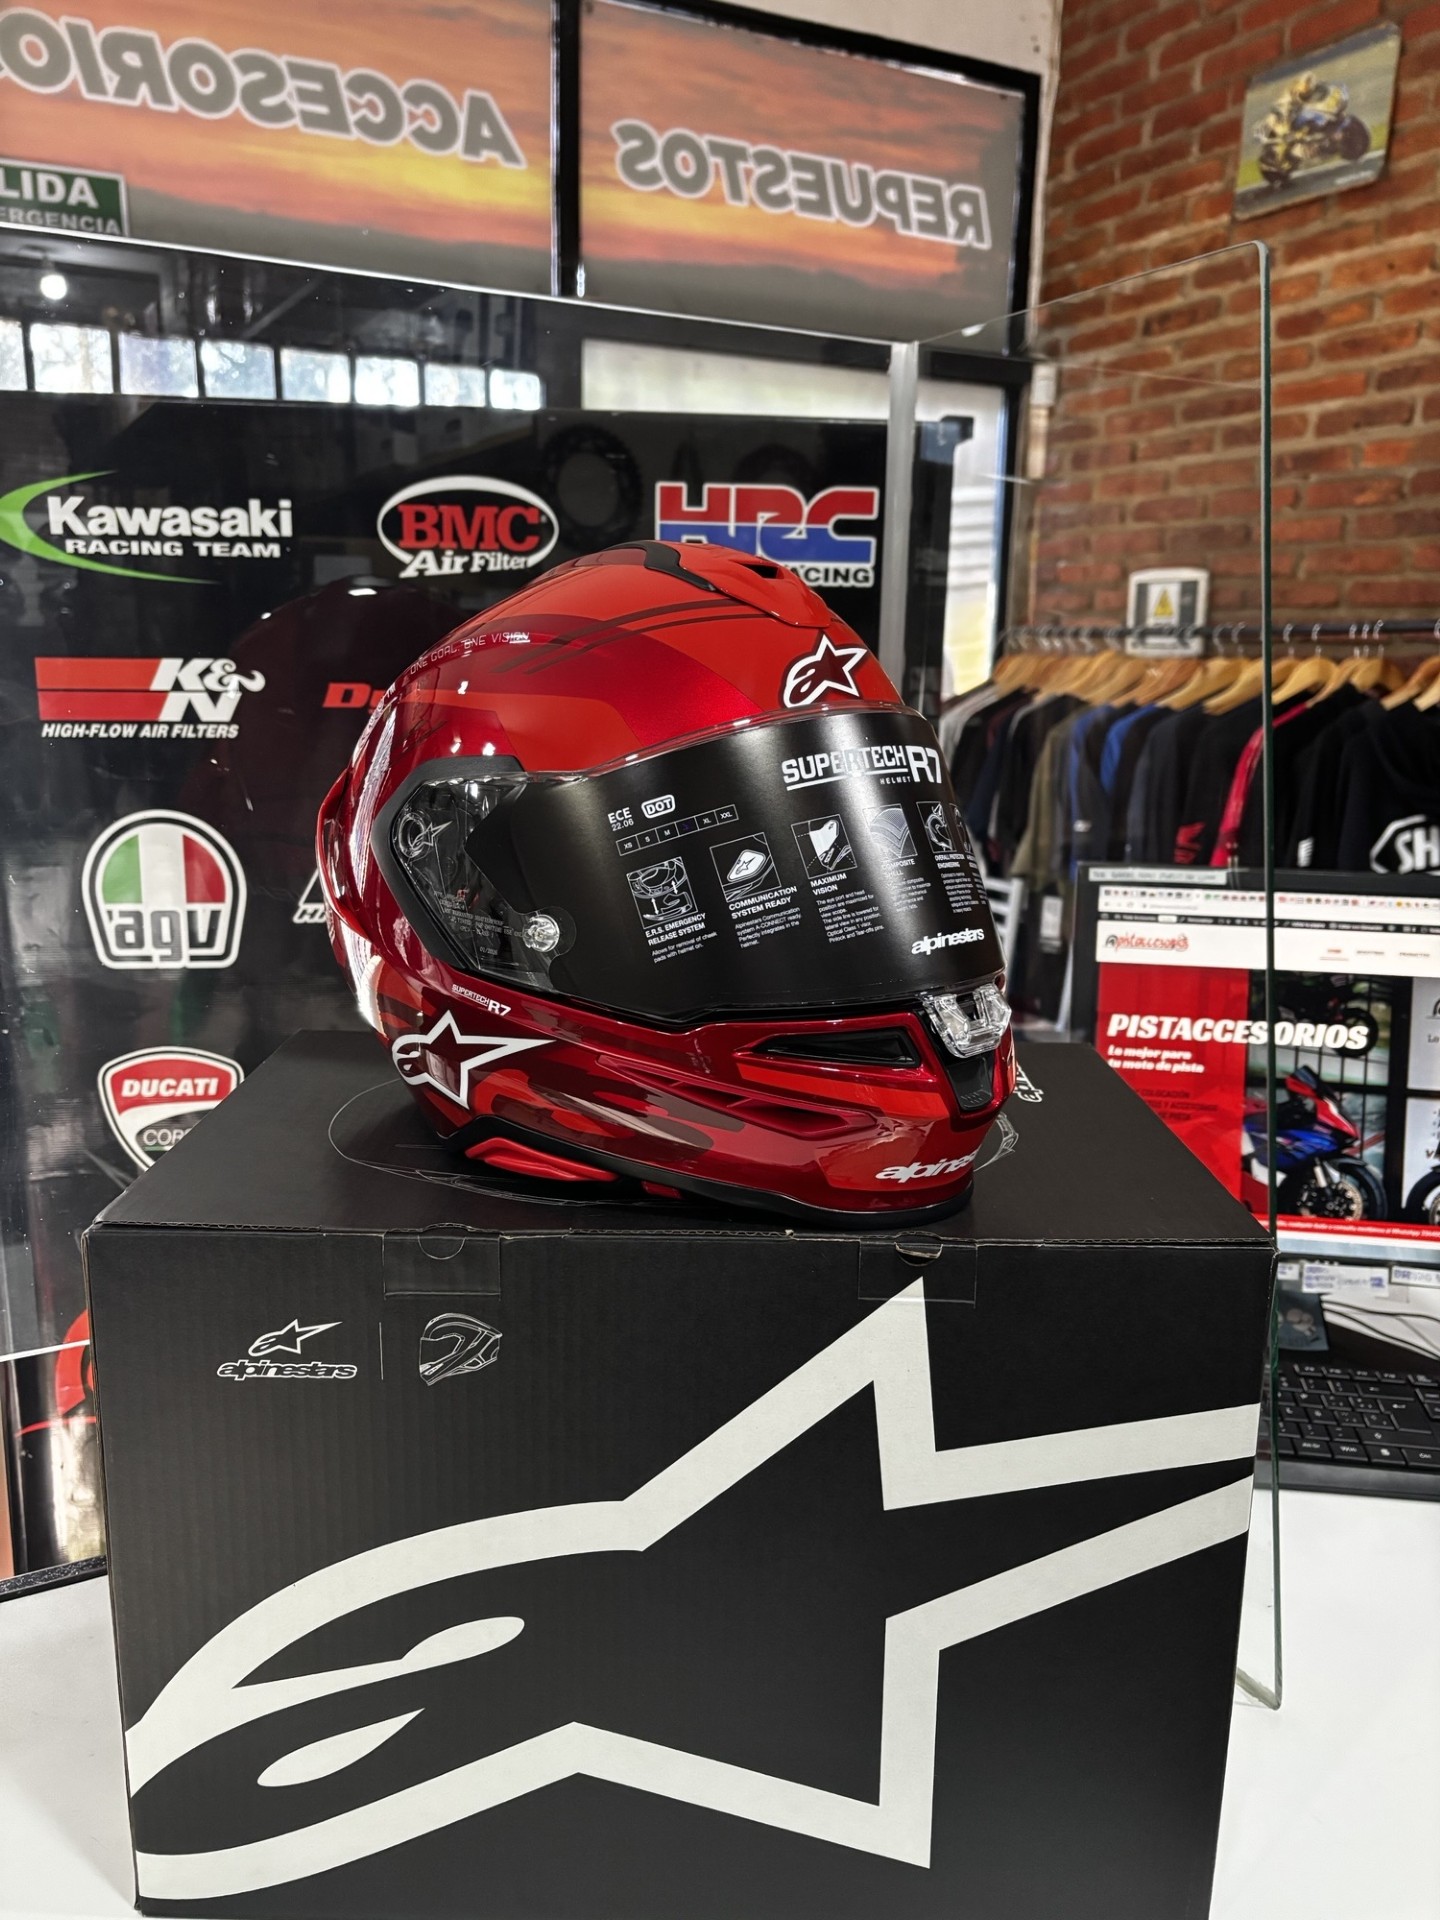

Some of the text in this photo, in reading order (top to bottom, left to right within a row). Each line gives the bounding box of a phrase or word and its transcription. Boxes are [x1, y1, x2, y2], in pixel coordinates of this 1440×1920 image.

[47, 496, 293, 537] Kawasaki
[397, 504, 540, 552] BMC
[655, 481, 880, 567] HRC
[65, 539, 281, 558] RACING TEAM
[399, 550, 469, 579] Air
[410, 657, 428, 675] ONE
[150, 657, 266, 722] K&N
[41, 723, 239, 739] HIGH-FLOW AIR FILTERS
[906, 745, 942, 784] R7
[880, 775, 911, 785] HELMET
[608, 807, 632, 824] ECE
[646, 798, 672, 815] DOT
[611, 818, 634, 832] 22.06
[810, 873, 847, 887] MAXIMUM
[813, 884, 838, 895] VISION
[729, 886, 797, 910] COMMUNICATION
[732, 896, 791, 919] SYSTEM READY
[115, 909, 222, 962] agv
[645, 912, 706, 938] E.R.S. EMERGENCY
[648, 922, 705, 946] RELEASE SYSTEM
[911, 928, 985, 955] alpinestars
[488, 999, 512, 1016] R7
[1107, 1014, 1369, 1050] PISTACCESORIOS
[121, 1078, 219, 1098] DUCATI
[217, 1360, 357, 1380] alpinestars
